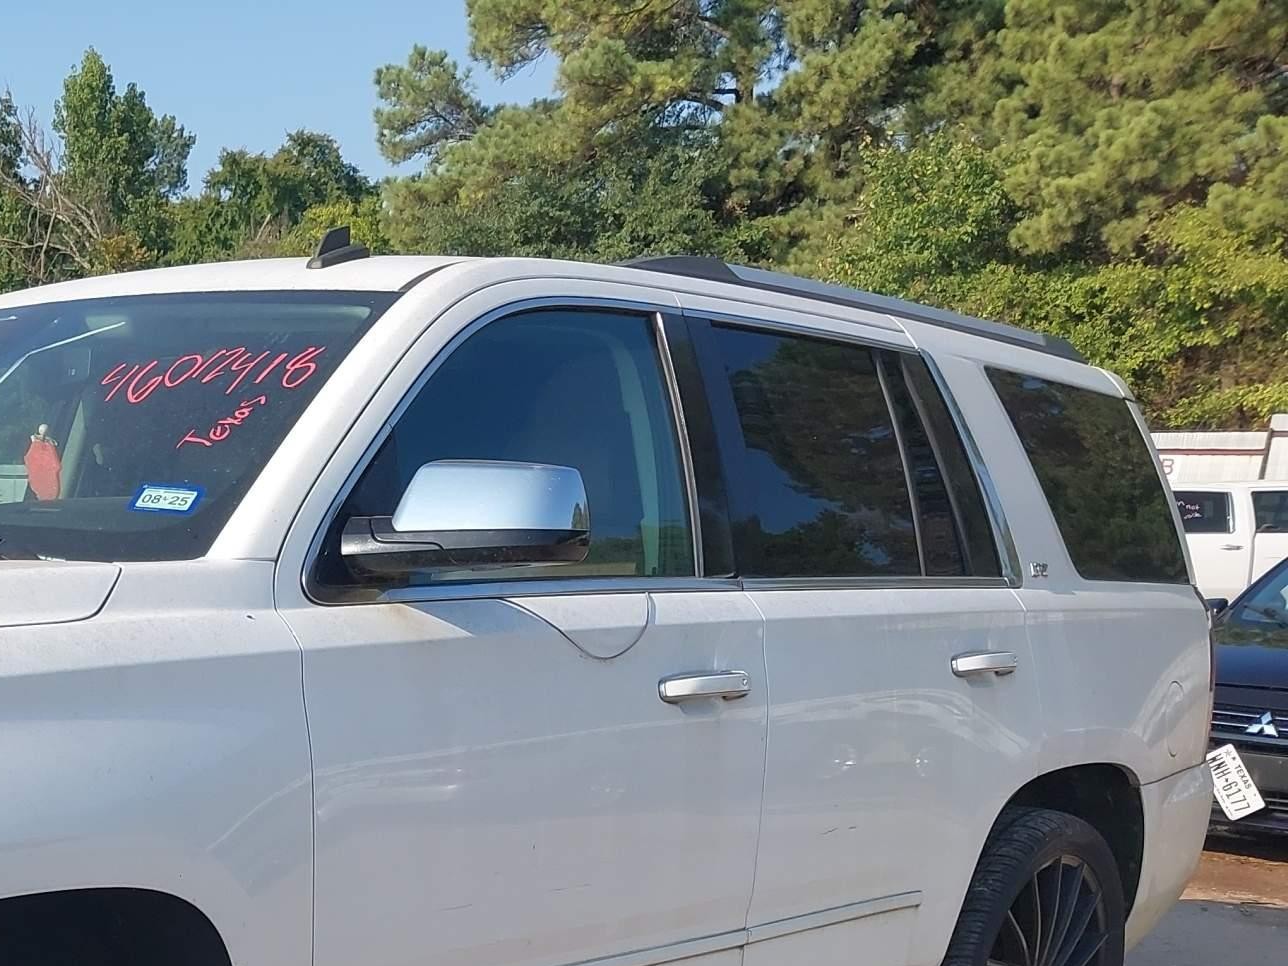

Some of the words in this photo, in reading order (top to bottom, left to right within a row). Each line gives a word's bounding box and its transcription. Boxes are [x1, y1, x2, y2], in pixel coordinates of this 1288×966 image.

[176, 395, 267, 449] Texas
[168, 495, 191, 507] 25
[1234, 764, 1252, 790] TEXAS
